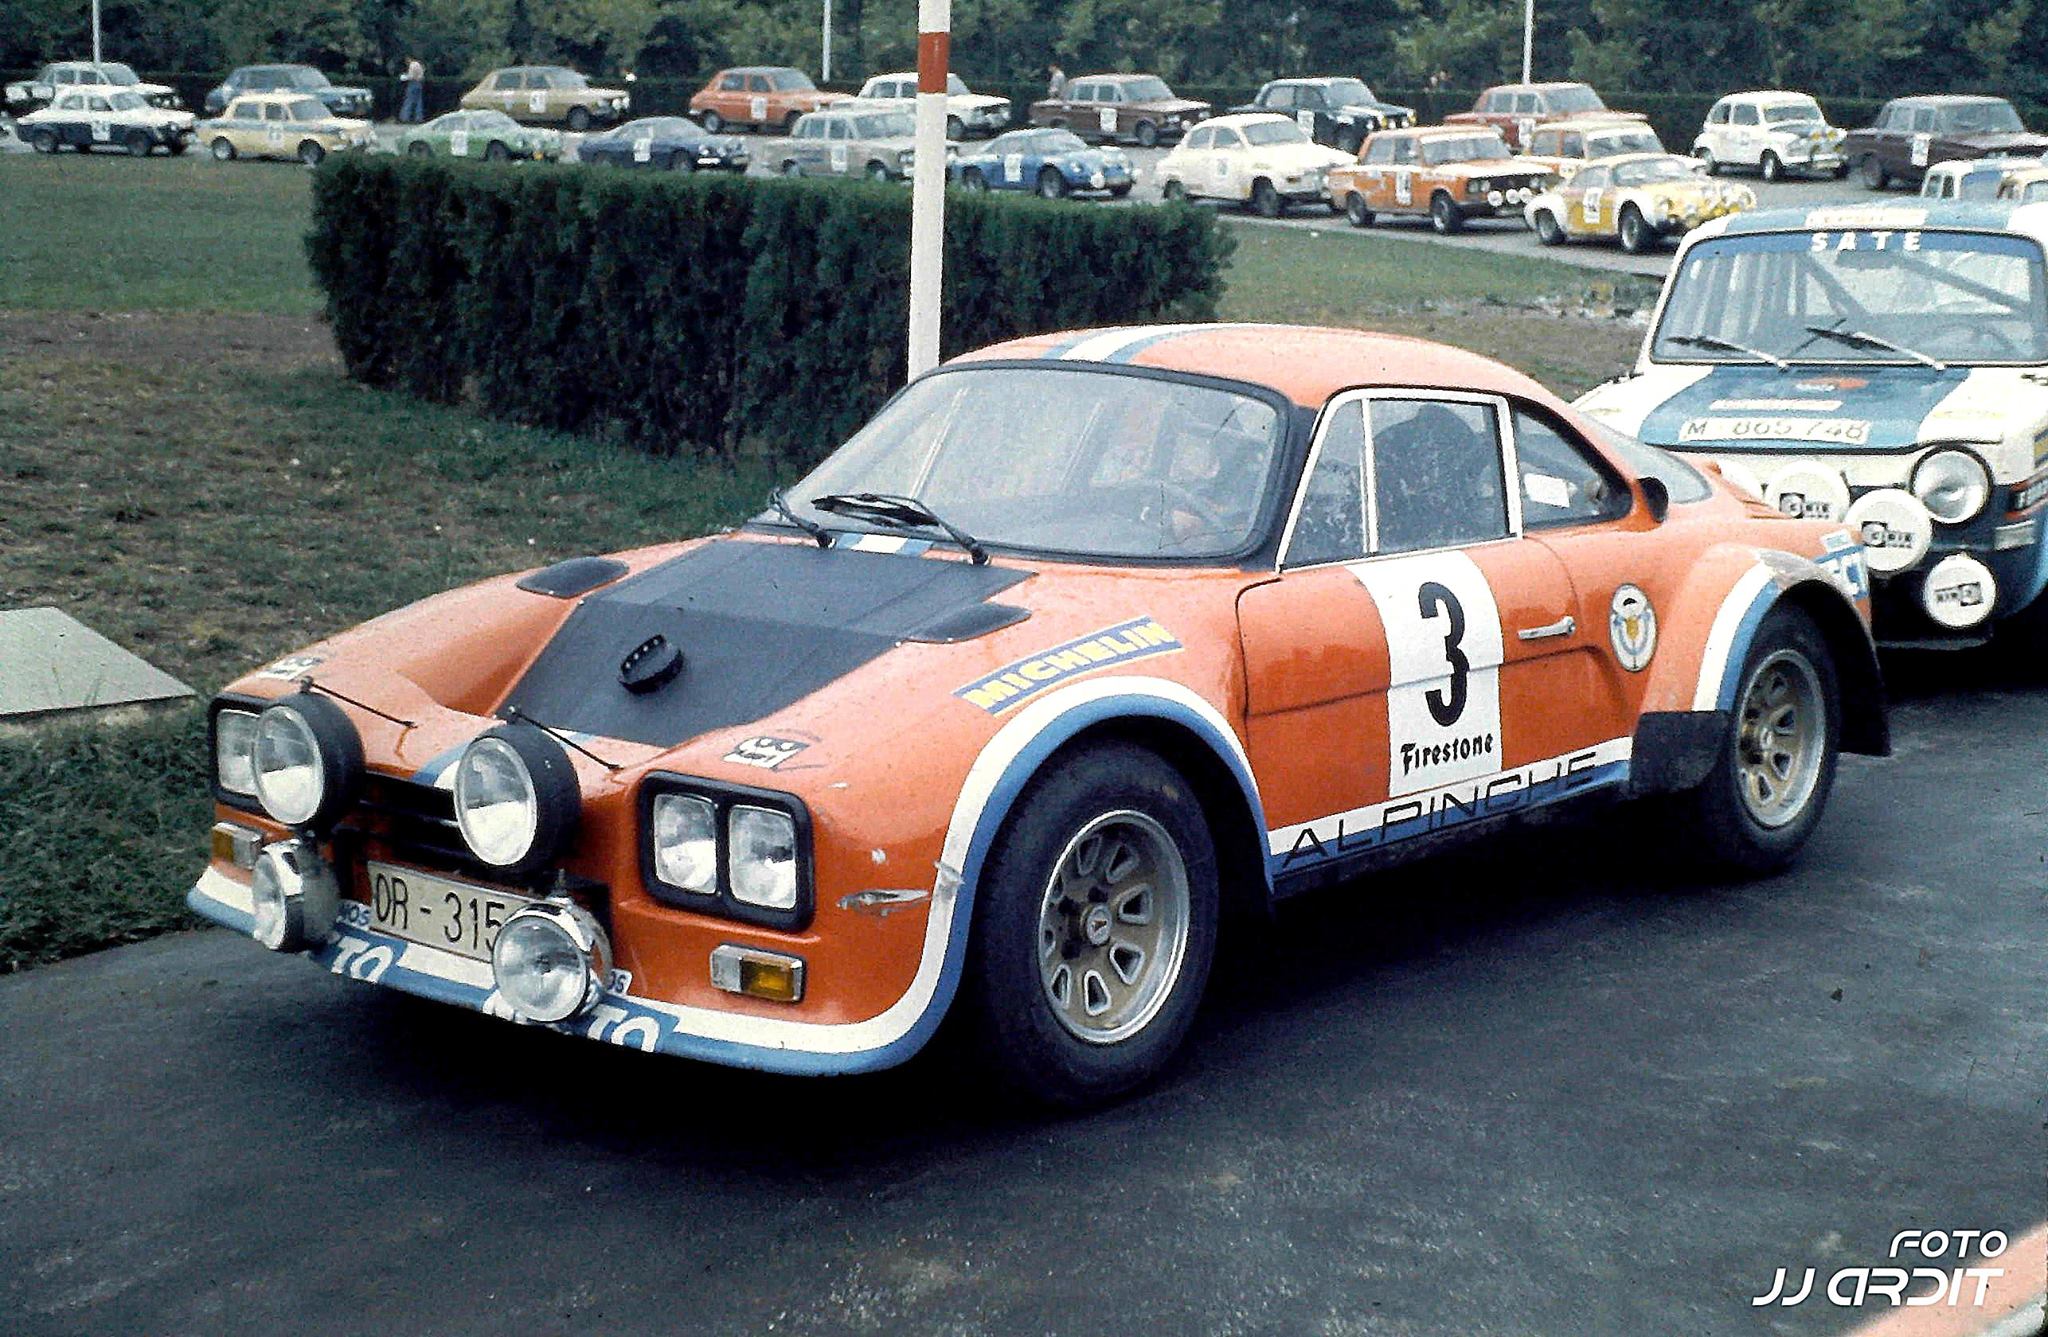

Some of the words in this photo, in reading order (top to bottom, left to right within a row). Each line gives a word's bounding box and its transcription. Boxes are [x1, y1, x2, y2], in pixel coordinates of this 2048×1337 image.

[1811, 230, 1921, 251] SATE
[962, 621, 1176, 709] MICHELIN
[1418, 581, 1470, 727] 3
[1400, 732, 1494, 776] Firestone
[1282, 750, 1598, 869] ALPINCHE
[444, 891, 505, 952] 315
[330, 935, 394, 984] TO
